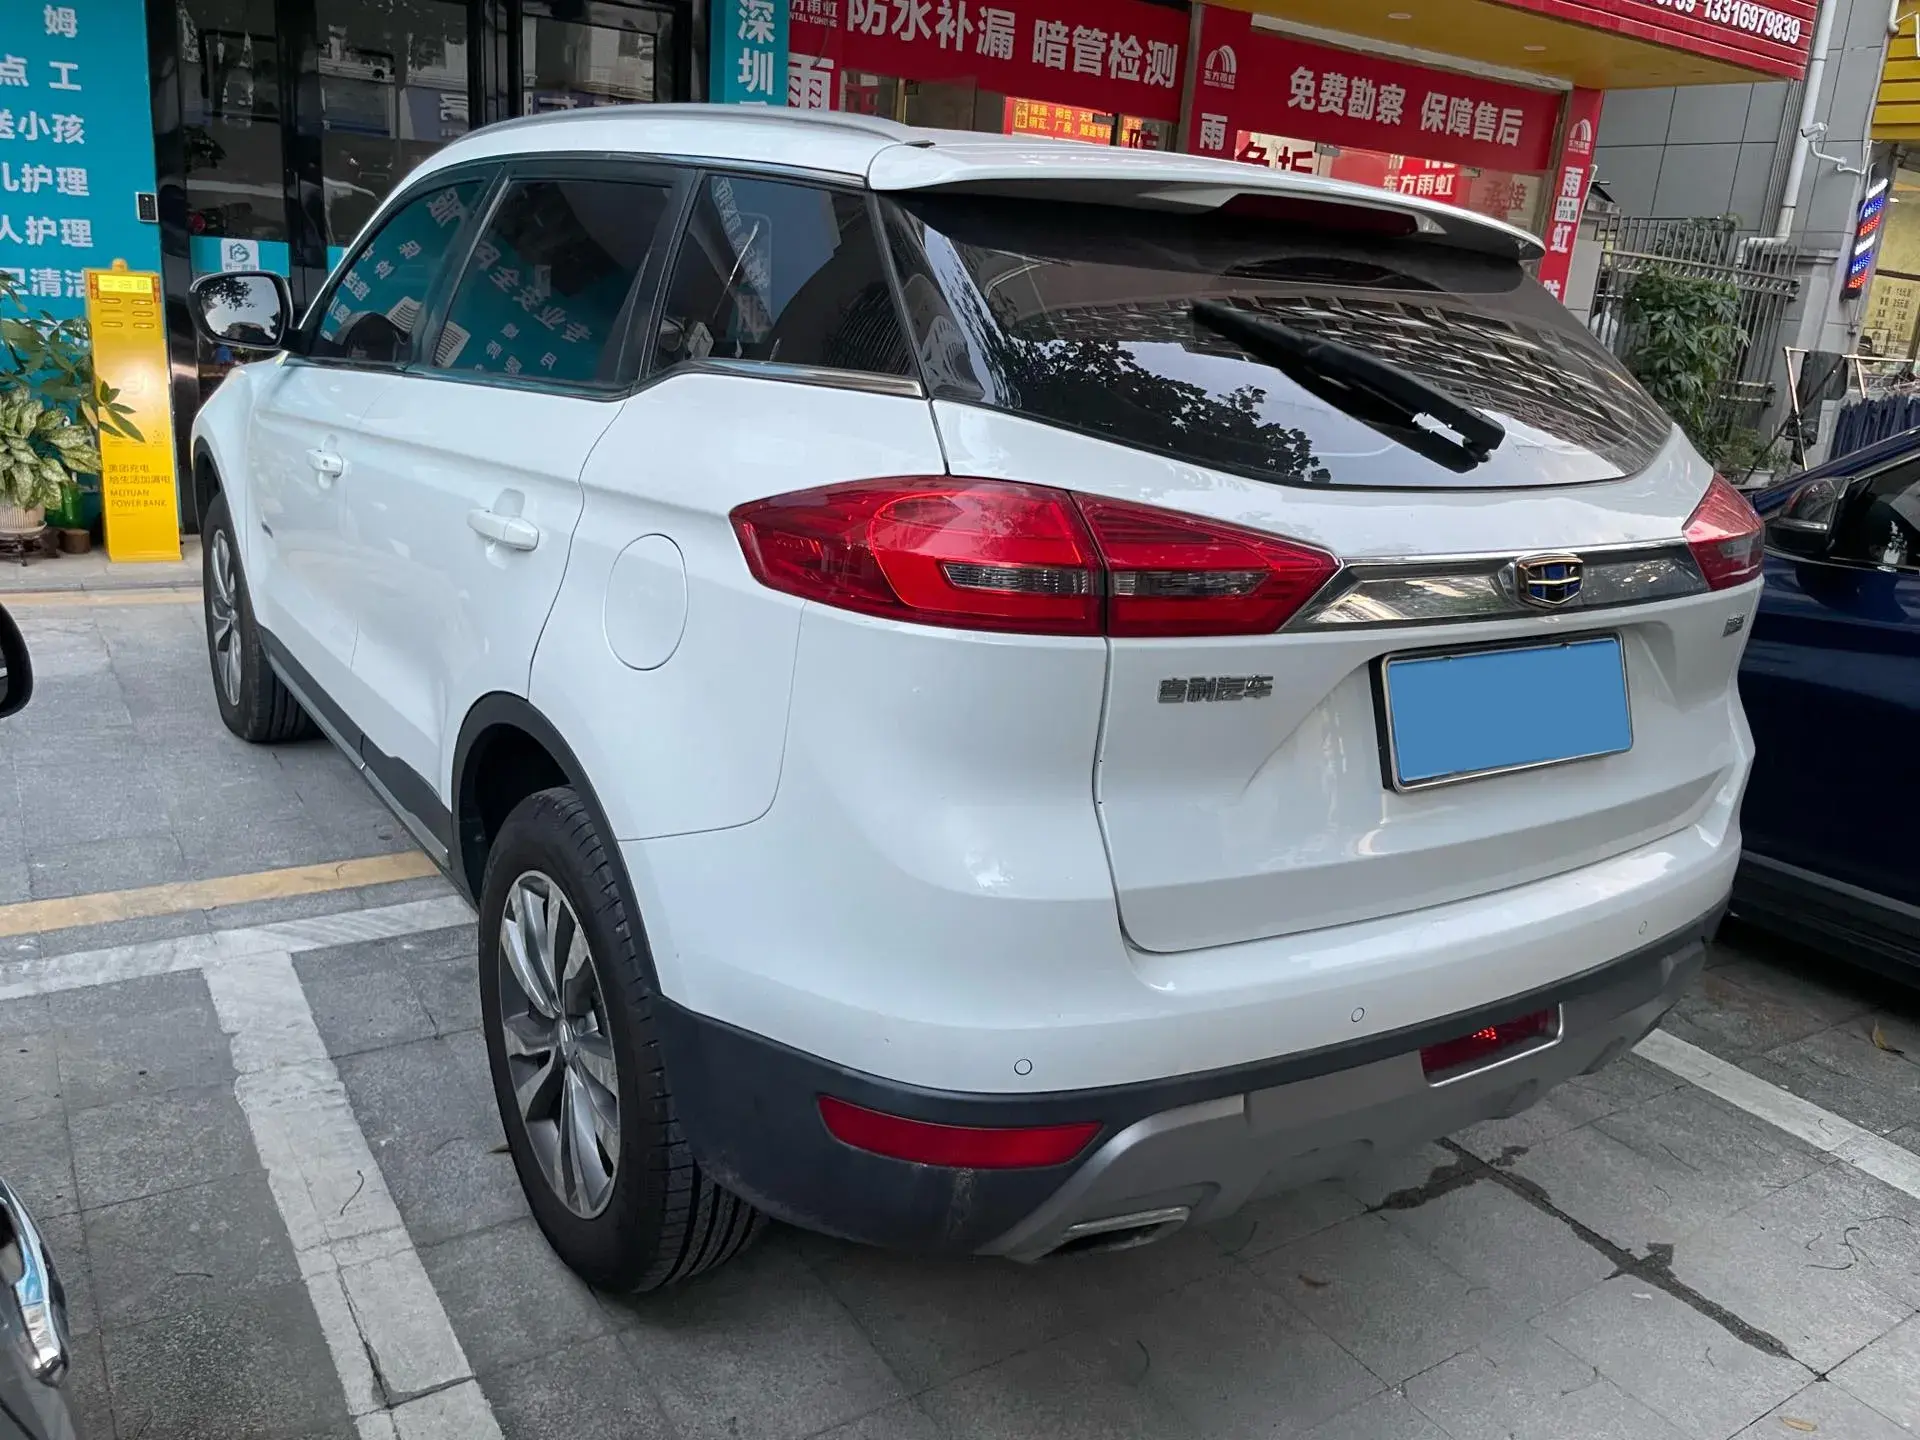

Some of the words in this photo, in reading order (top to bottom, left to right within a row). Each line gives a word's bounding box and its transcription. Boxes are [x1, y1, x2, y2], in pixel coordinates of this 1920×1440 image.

[846, 0, 1015, 60] 防水补漏
[1032, 19, 1178, 88] 暗管检测
[1702, 0, 1800, 44] 13316979839
[1288, 66, 1405, 125] 免费勘察
[1420, 91, 1523, 146] 保障售后
[112, 499, 141, 509] POWER
[143, 500, 168, 508] BANK
